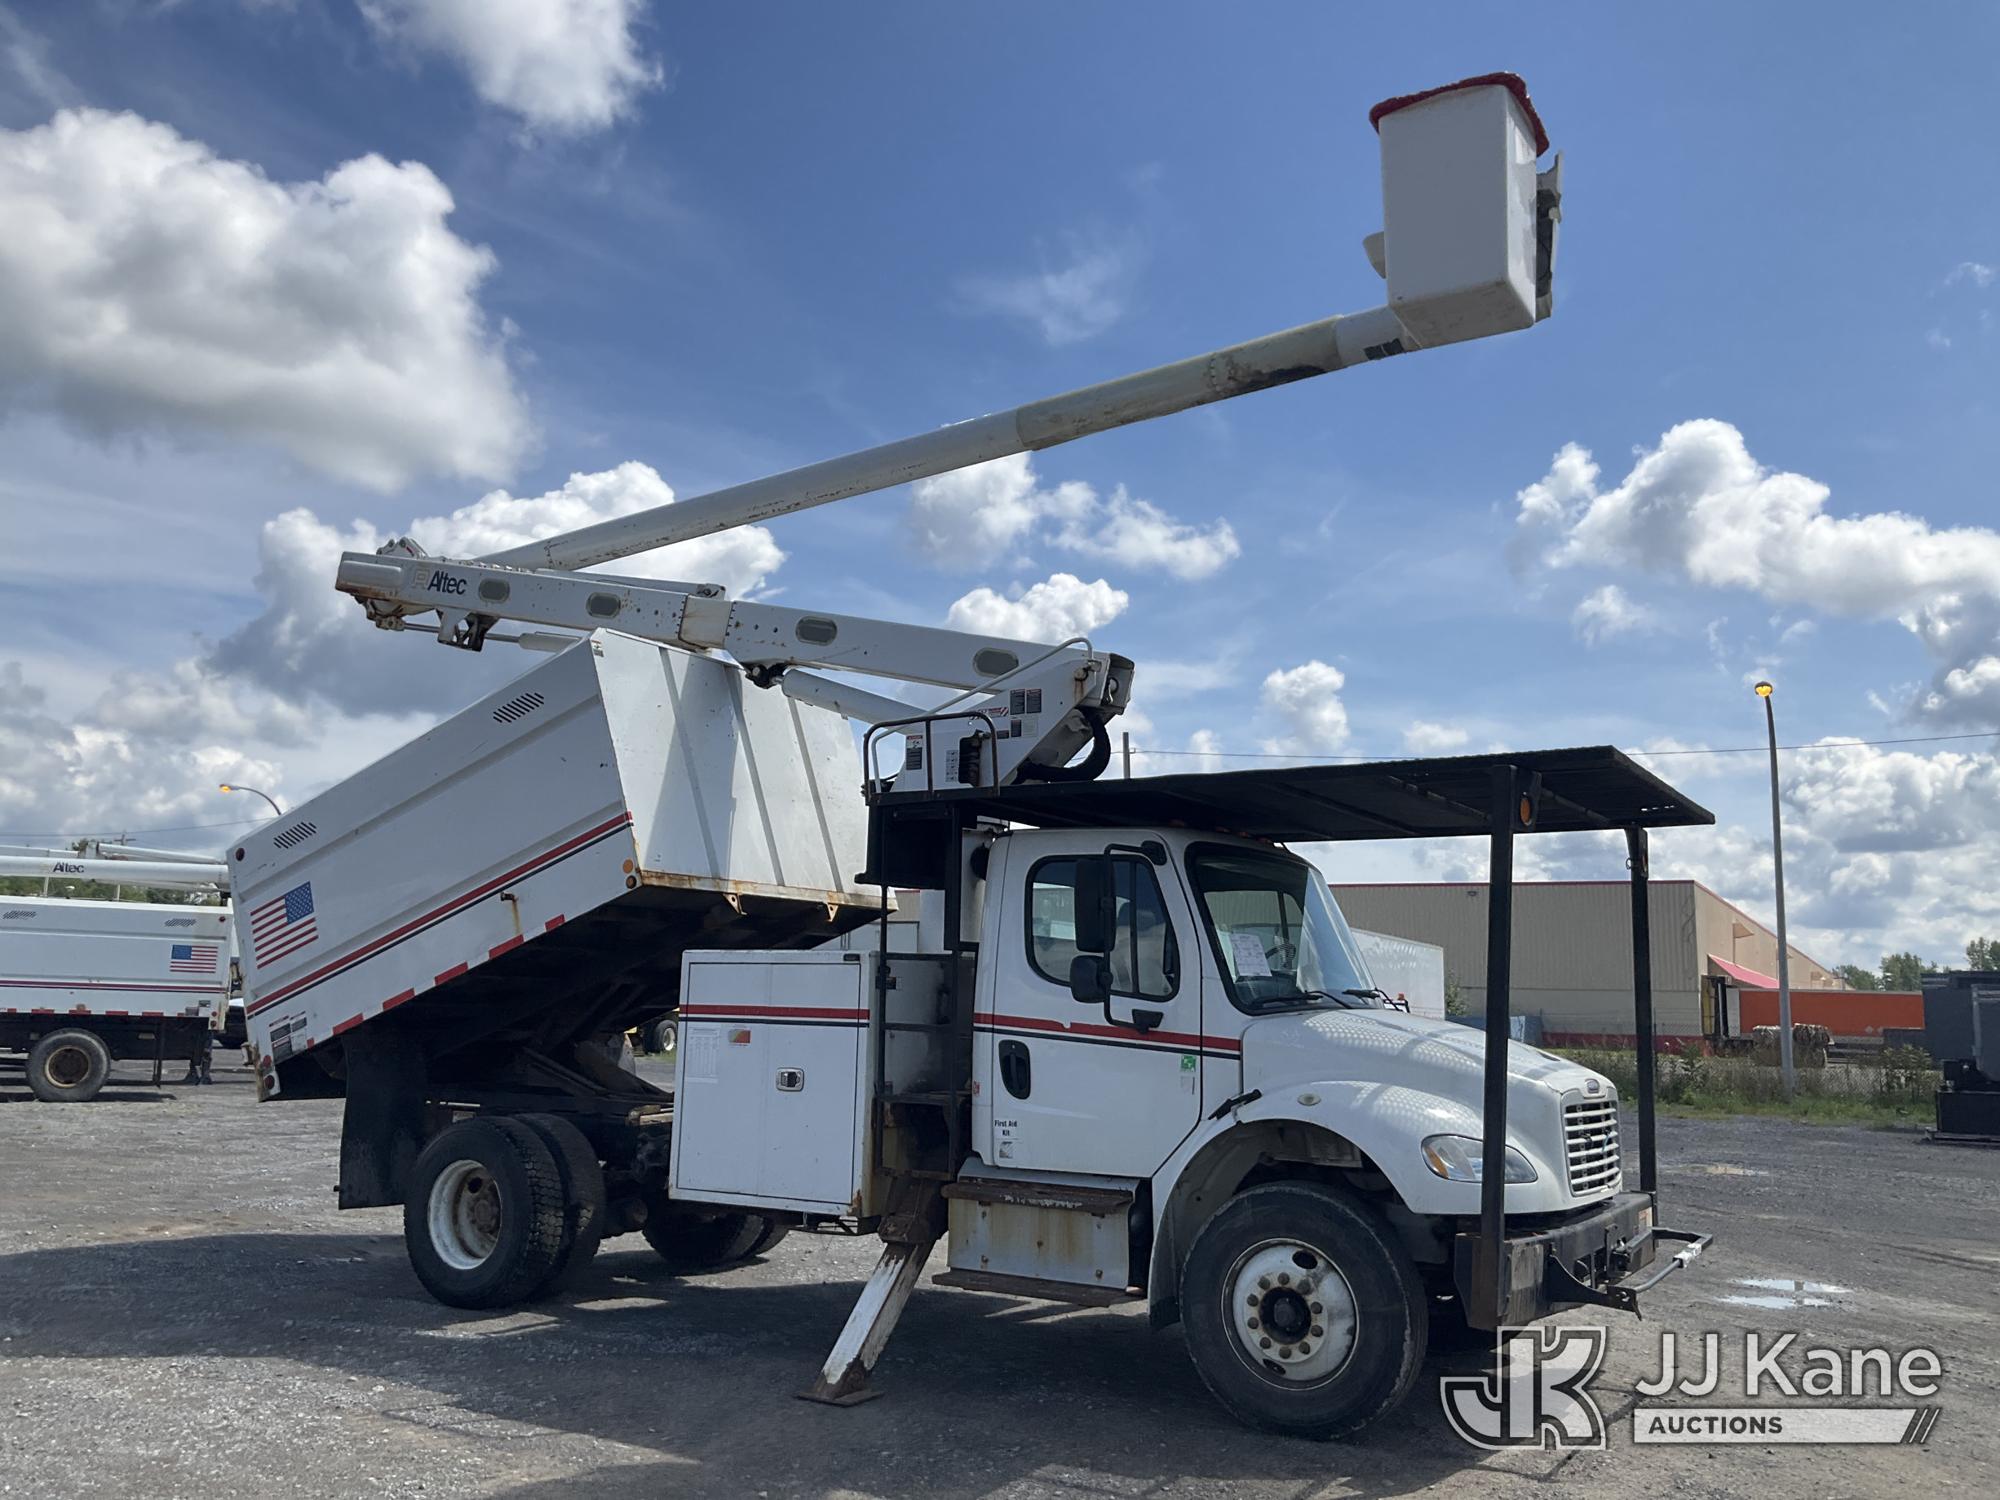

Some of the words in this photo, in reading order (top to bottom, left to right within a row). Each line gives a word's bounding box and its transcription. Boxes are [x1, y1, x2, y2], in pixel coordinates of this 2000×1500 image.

[427, 569, 468, 596] Altec
[53, 862, 85, 873] Altec
[994, 1119, 1007, 1128] First
[1008, 1120, 1018, 1128] Aid
